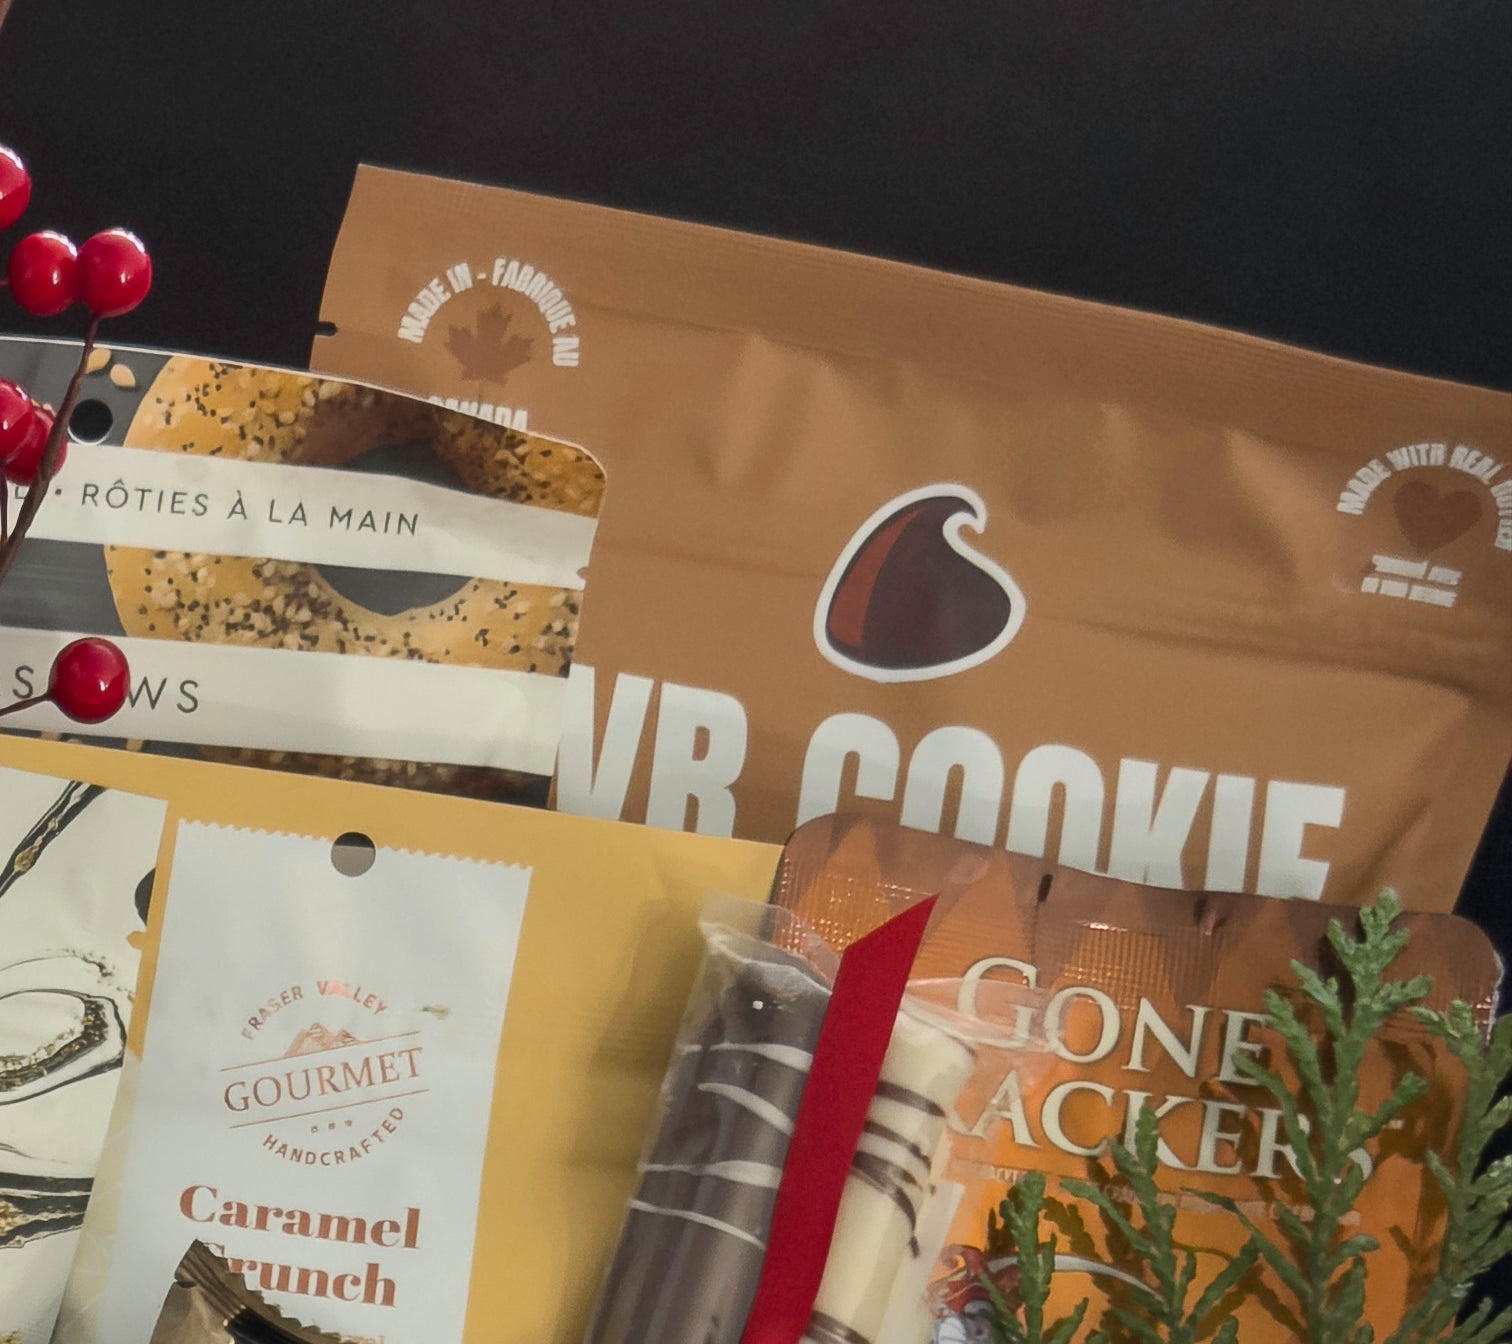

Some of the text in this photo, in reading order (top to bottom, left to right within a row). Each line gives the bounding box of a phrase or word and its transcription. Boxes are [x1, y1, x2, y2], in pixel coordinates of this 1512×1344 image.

[397, 277, 452, 344] MADE
[446, 262, 473, 293] IN
[492, 258, 576, 334] FABRIQUE
[552, 335, 579, 367] AU
[81, 478, 209, 517] RÔTIES
[227, 490, 248, 521] À
[268, 498, 308, 527] LA
[330, 505, 420, 537] MAIN
[1336, 458, 1392, 515] MADE
[1386, 443, 1447, 471] WITH
[1448, 444, 1504, 485] REAL
[795, 712, 1346, 901] COOKIE
[240, 985, 304, 1041] FRASER
[956, 957, 1271, 1087] GONE
[223, 1047, 424, 1113] GOURMET
[263, 1107, 404, 1166] HANDCRAFTED
[179, 1184, 421, 1249] Caramel
[203, 1241, 397, 1308] runch
